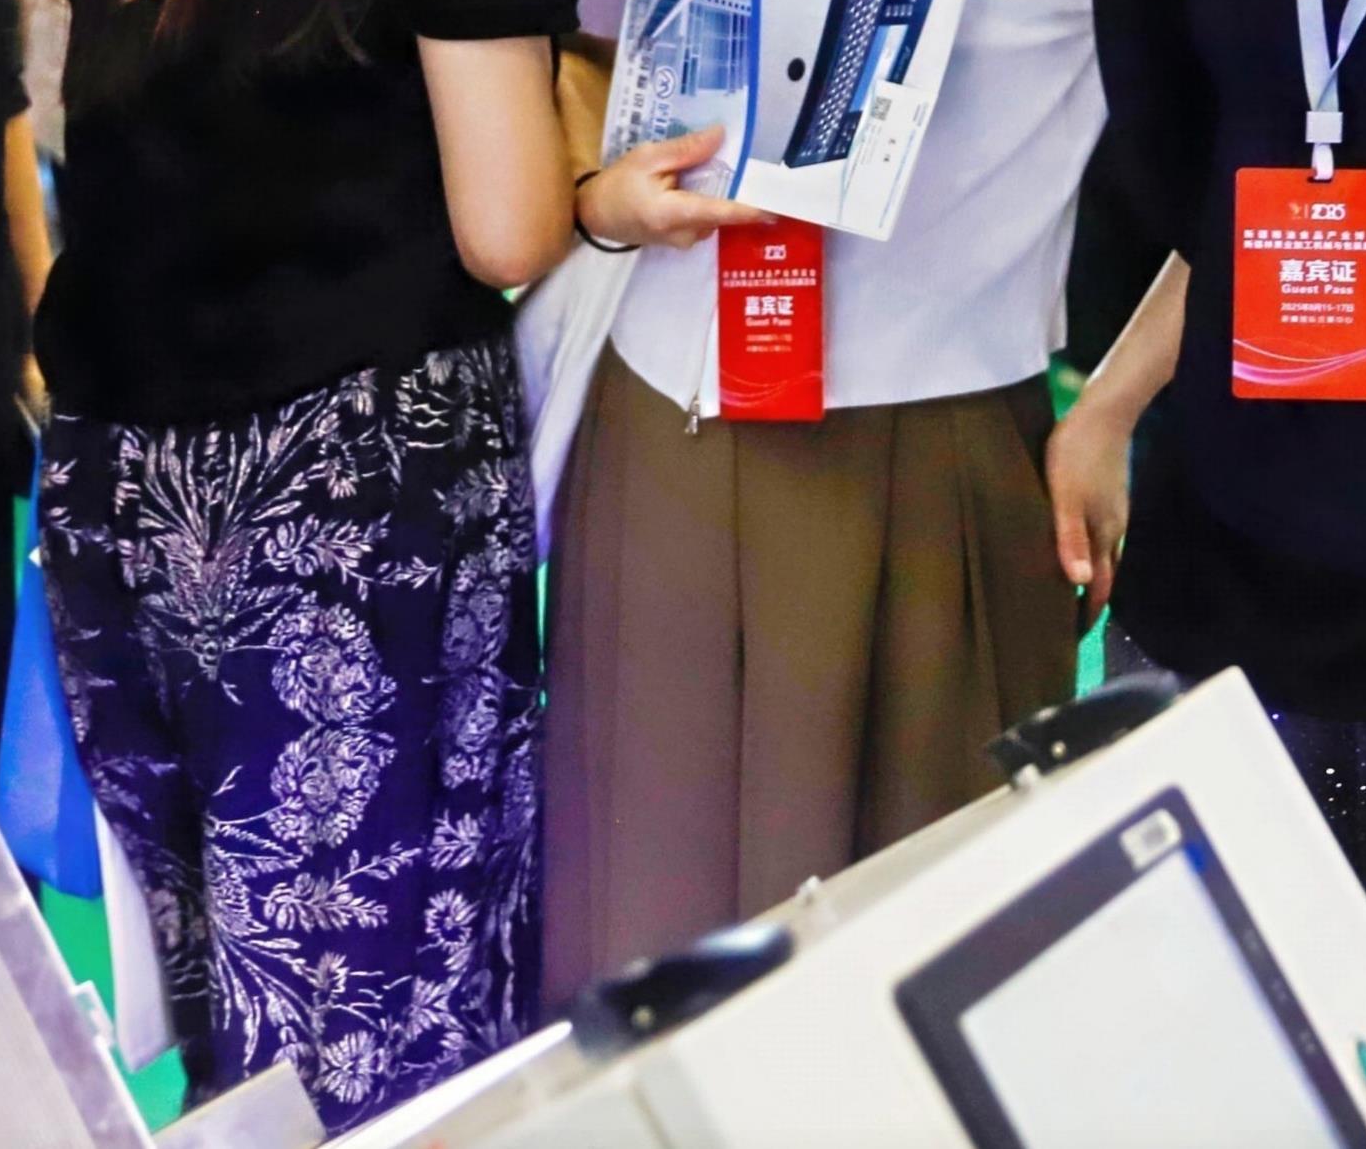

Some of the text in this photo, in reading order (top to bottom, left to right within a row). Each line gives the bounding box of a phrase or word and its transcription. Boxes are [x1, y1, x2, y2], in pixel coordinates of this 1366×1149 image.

[1279, 259, 1357, 283] 嘉宾证
[1281, 283, 1354, 295] Guest Pass
[745, 295, 794, 317] 嘉宾证
